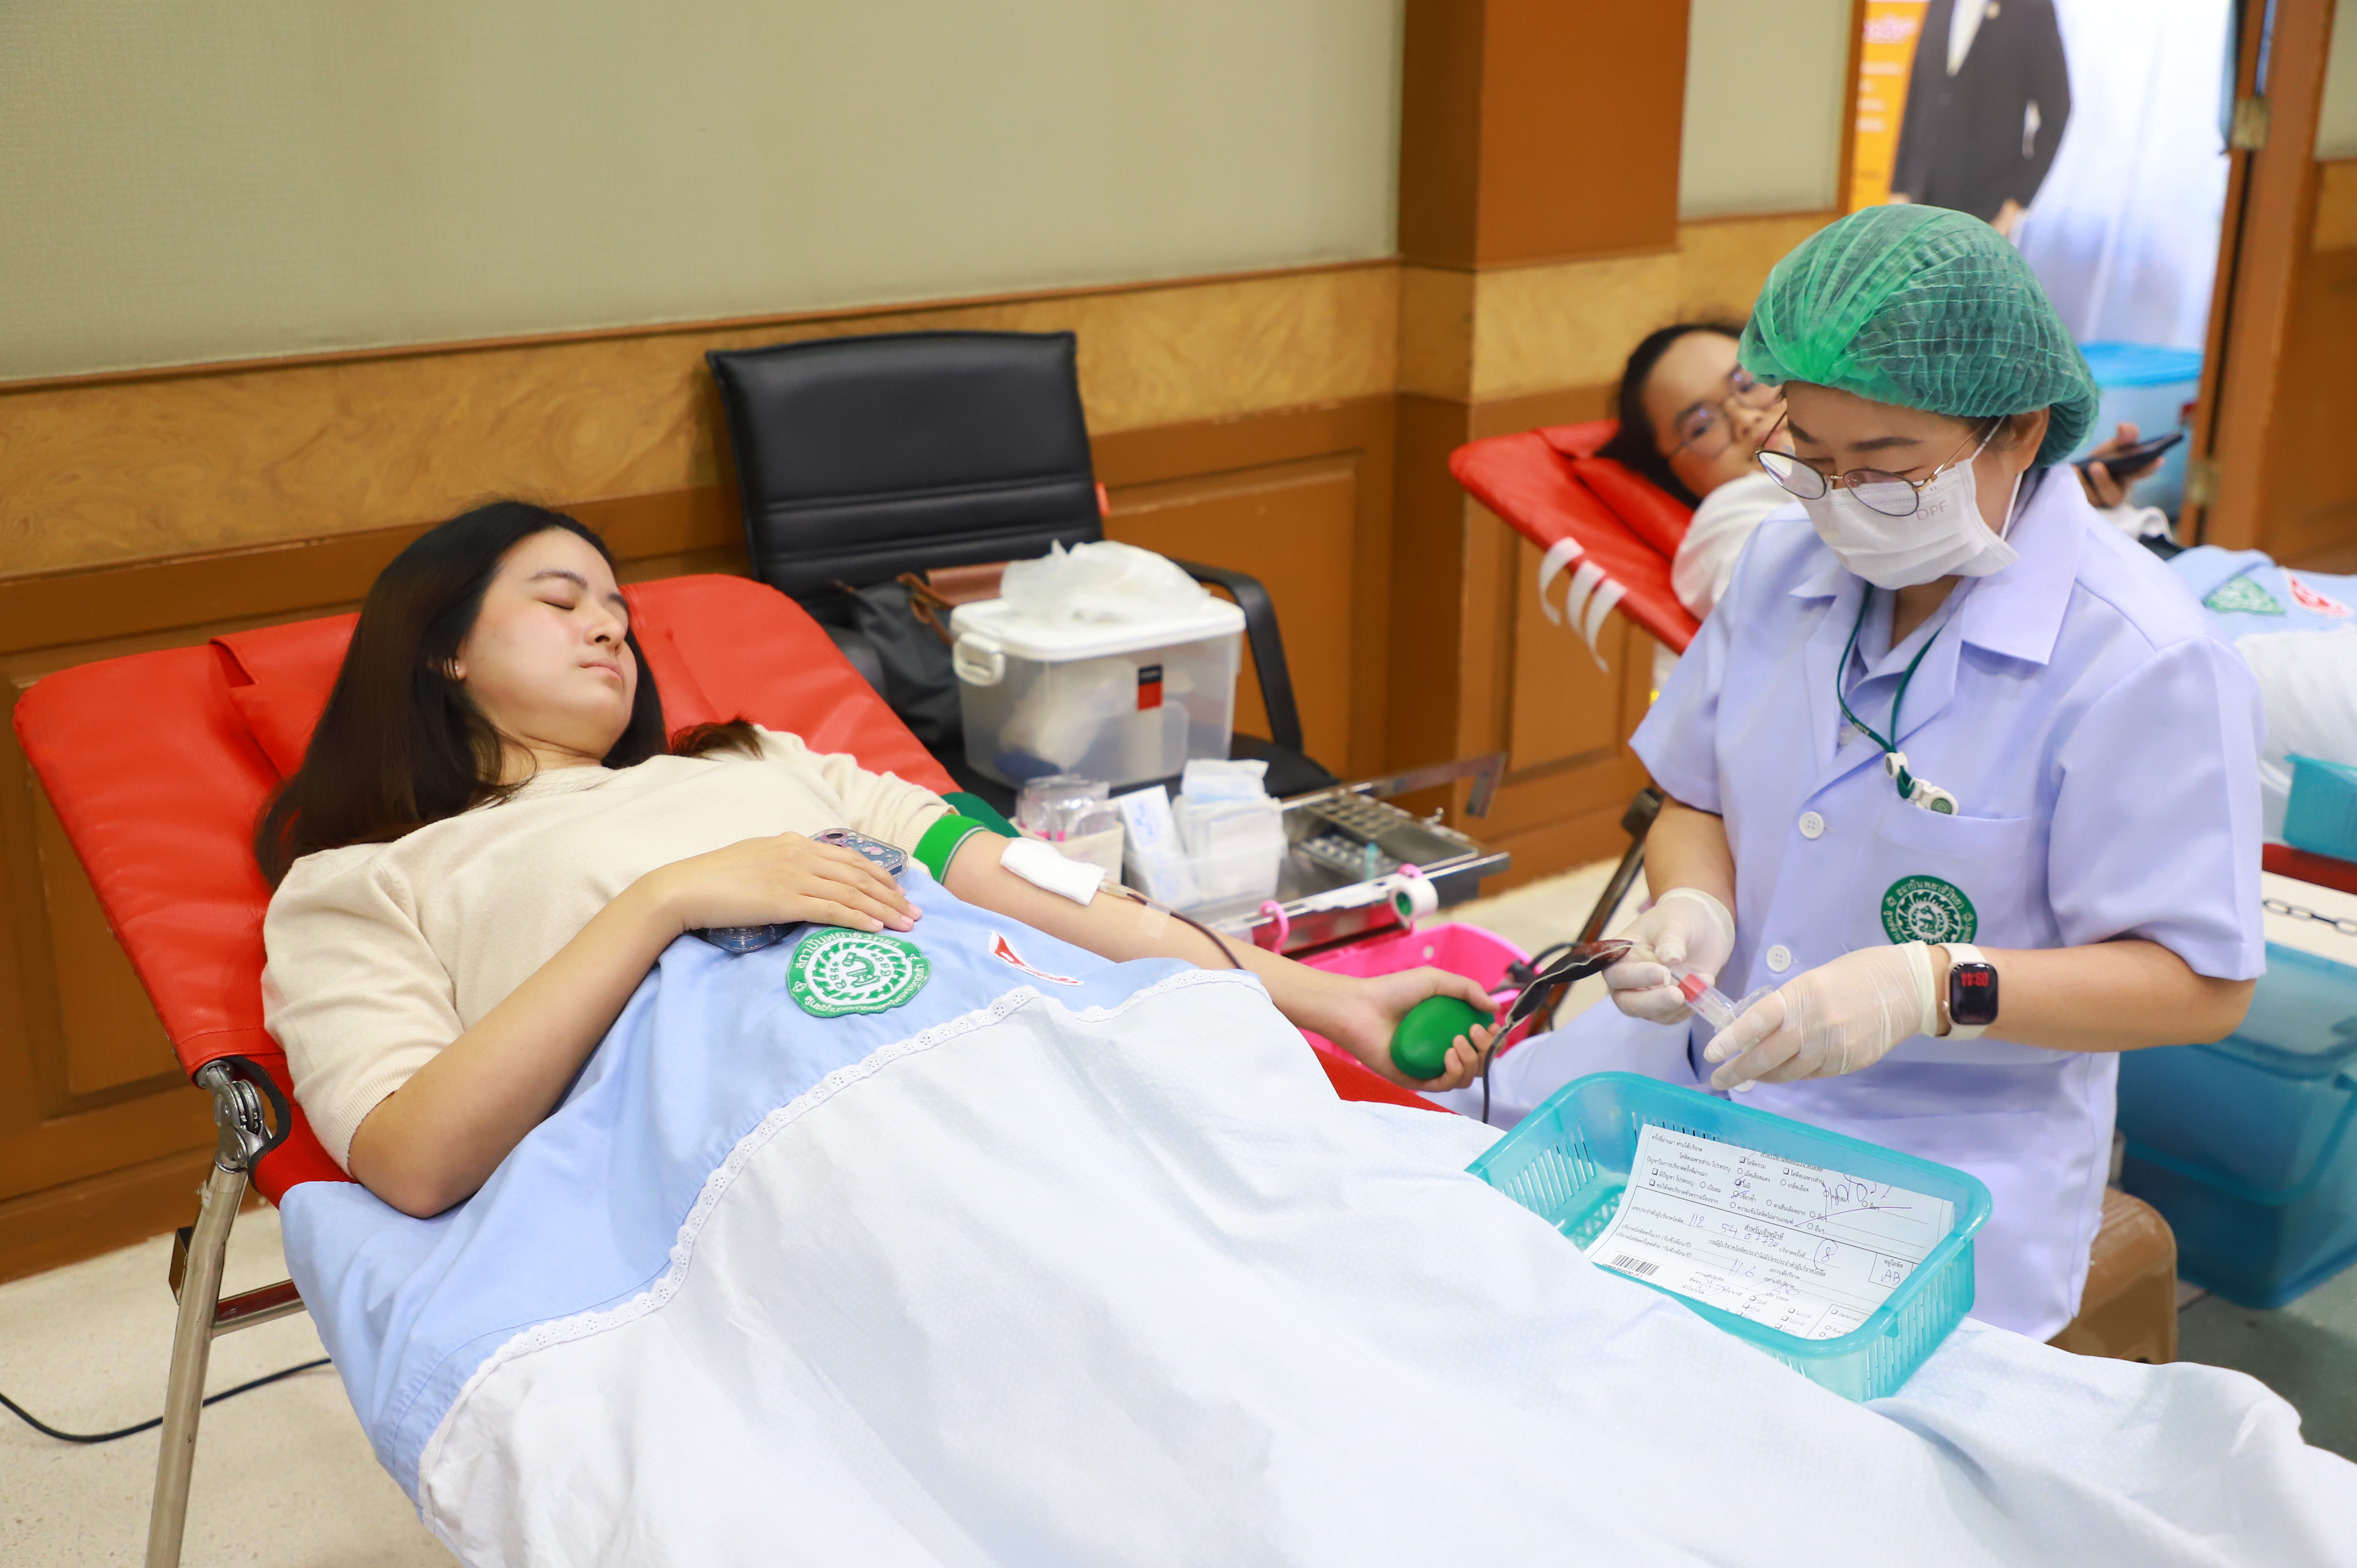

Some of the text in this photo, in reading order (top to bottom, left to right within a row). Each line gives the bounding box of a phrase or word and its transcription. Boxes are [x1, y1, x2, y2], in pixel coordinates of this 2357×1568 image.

[795, 931, 901, 969] สถาบันพยาธิวิทยา
[1651, 1133, 1703, 1153] ครั้งที่ผ่านมา ท่านได้บริจาค
[1679, 1152, 1711, 1166] โลหิตเฉพาะส่วน
[1747, 1158, 1766, 1169] โลหิตรวม
[1647, 1156, 1708, 1178] ปัญหาในการบริจาคครั้งที่ผ่านมา
[1658, 1170, 1675, 1182] มีปัญหา
[1745, 1170, 1771, 1182] เม็ดเลือดแดง
[1790, 1170, 1824, 1184] โลหิตเฉพาะส่วน
[1657, 1183, 1718, 1204] ขอให้งดบริจาคชั่วคราวเนื่องจาก
[1707, 1183, 1722, 1193] เป็นลม
[1788, 1182, 1810, 1193] เกล็ดเลือด
[1631, 1205, 1684, 1224] เลขประจำตัวผู้บริจาคโลหิต
[1737, 1204, 1794, 1225] ความเข้มโลหิตไม่ผ่านเกณฑ์
[1773, 1202, 1806, 1216] หาเส้นเลือดยาก
[1622, 1224, 1661, 1239] บริจาคโลหิตครั้งแรก
[1744, 1224, 1784, 1241] สำหรับเจ้าหน้าที่
[1616, 1232, 1661, 1249] บริจาคโลหิตครั้งสุดท้าย
[1779, 1246, 1806, 1259] บริจาคครั้งที่
[1884, 1258, 1904, 1269] หมู่โลหิต
[1769, 1267, 1800, 1280] สถานที่บริจาค
[1881, 1269, 1901, 1286] AB
[1838, 1313, 1861, 1323] Deferred
